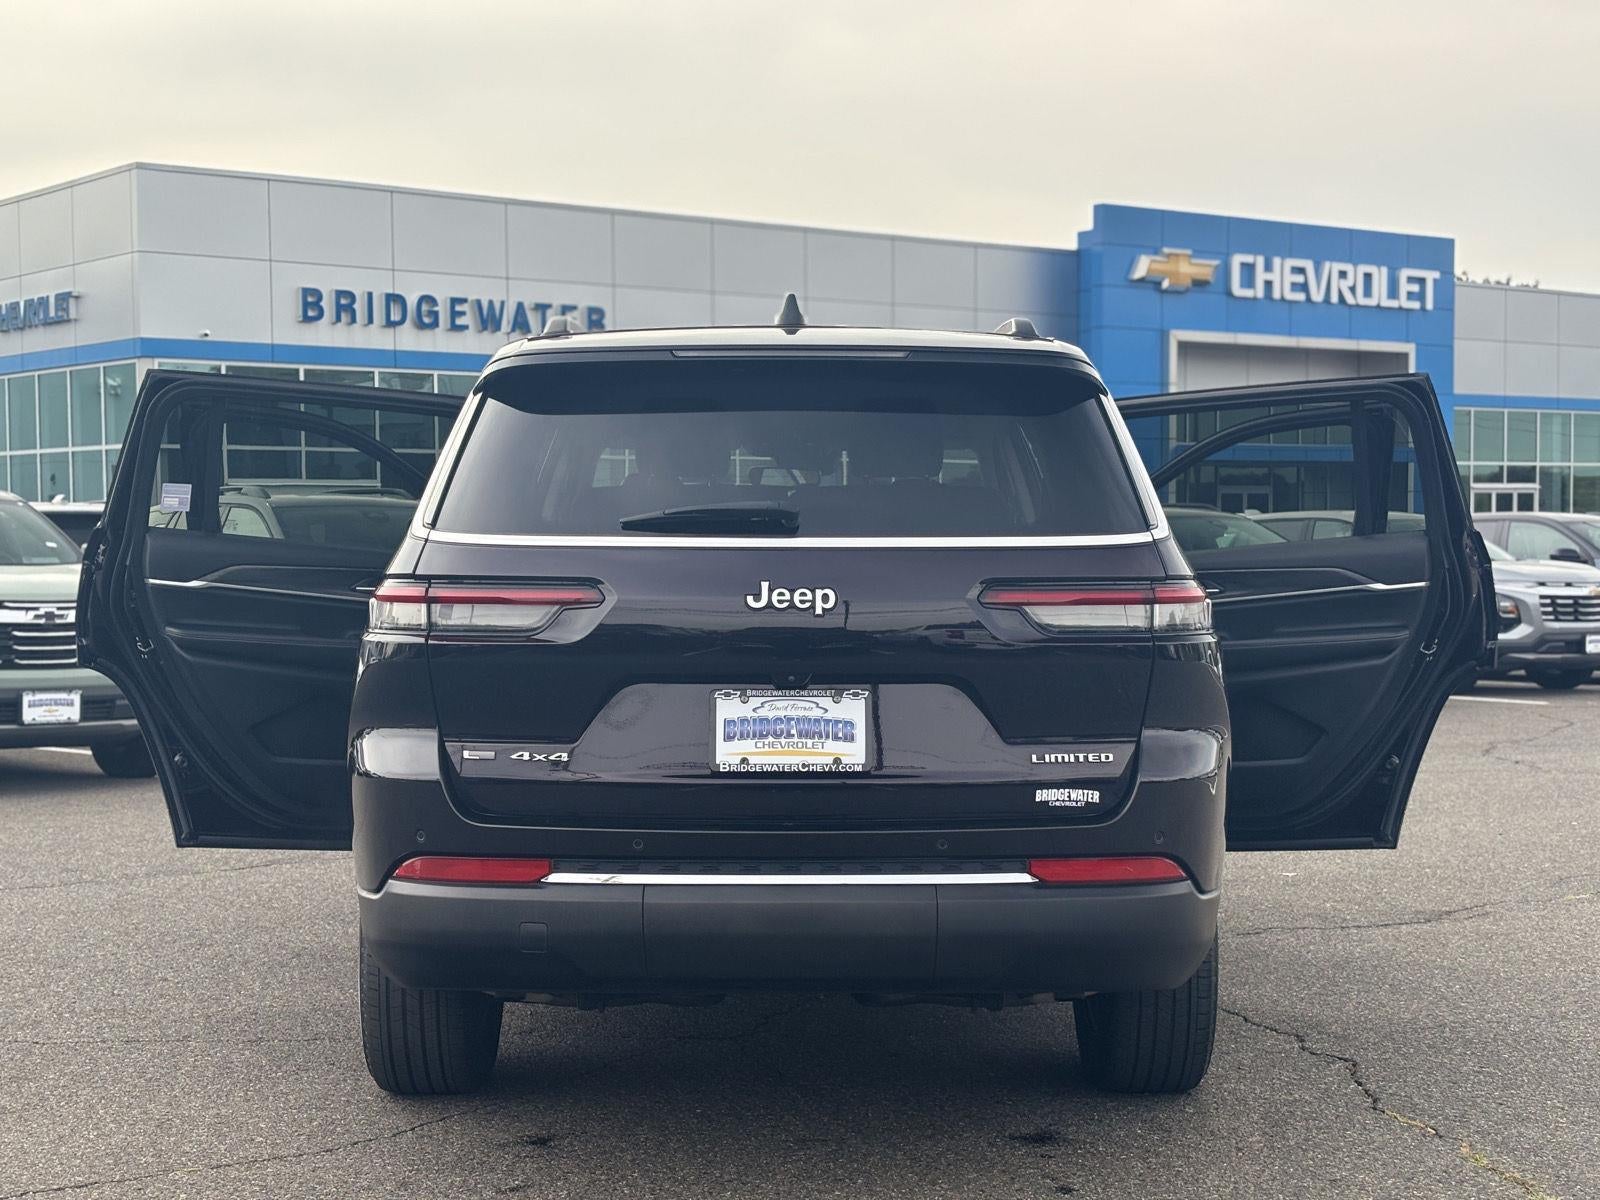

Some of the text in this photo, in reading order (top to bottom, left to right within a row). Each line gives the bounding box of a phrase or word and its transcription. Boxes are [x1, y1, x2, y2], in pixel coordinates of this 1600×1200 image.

[1230, 253, 1441, 311] CHEVROLET
[0, 290, 76, 332] HEVROLET
[745, 580, 837, 615] Jeep
[723, 714, 857, 743] BRIDGEWATER
[510, 751, 569, 761] 4x4
[754, 740, 827, 750] CHEVROLET
[1031, 753, 1114, 763] LIMITED
[1035, 788, 1100, 803] BRIDGEWATER
